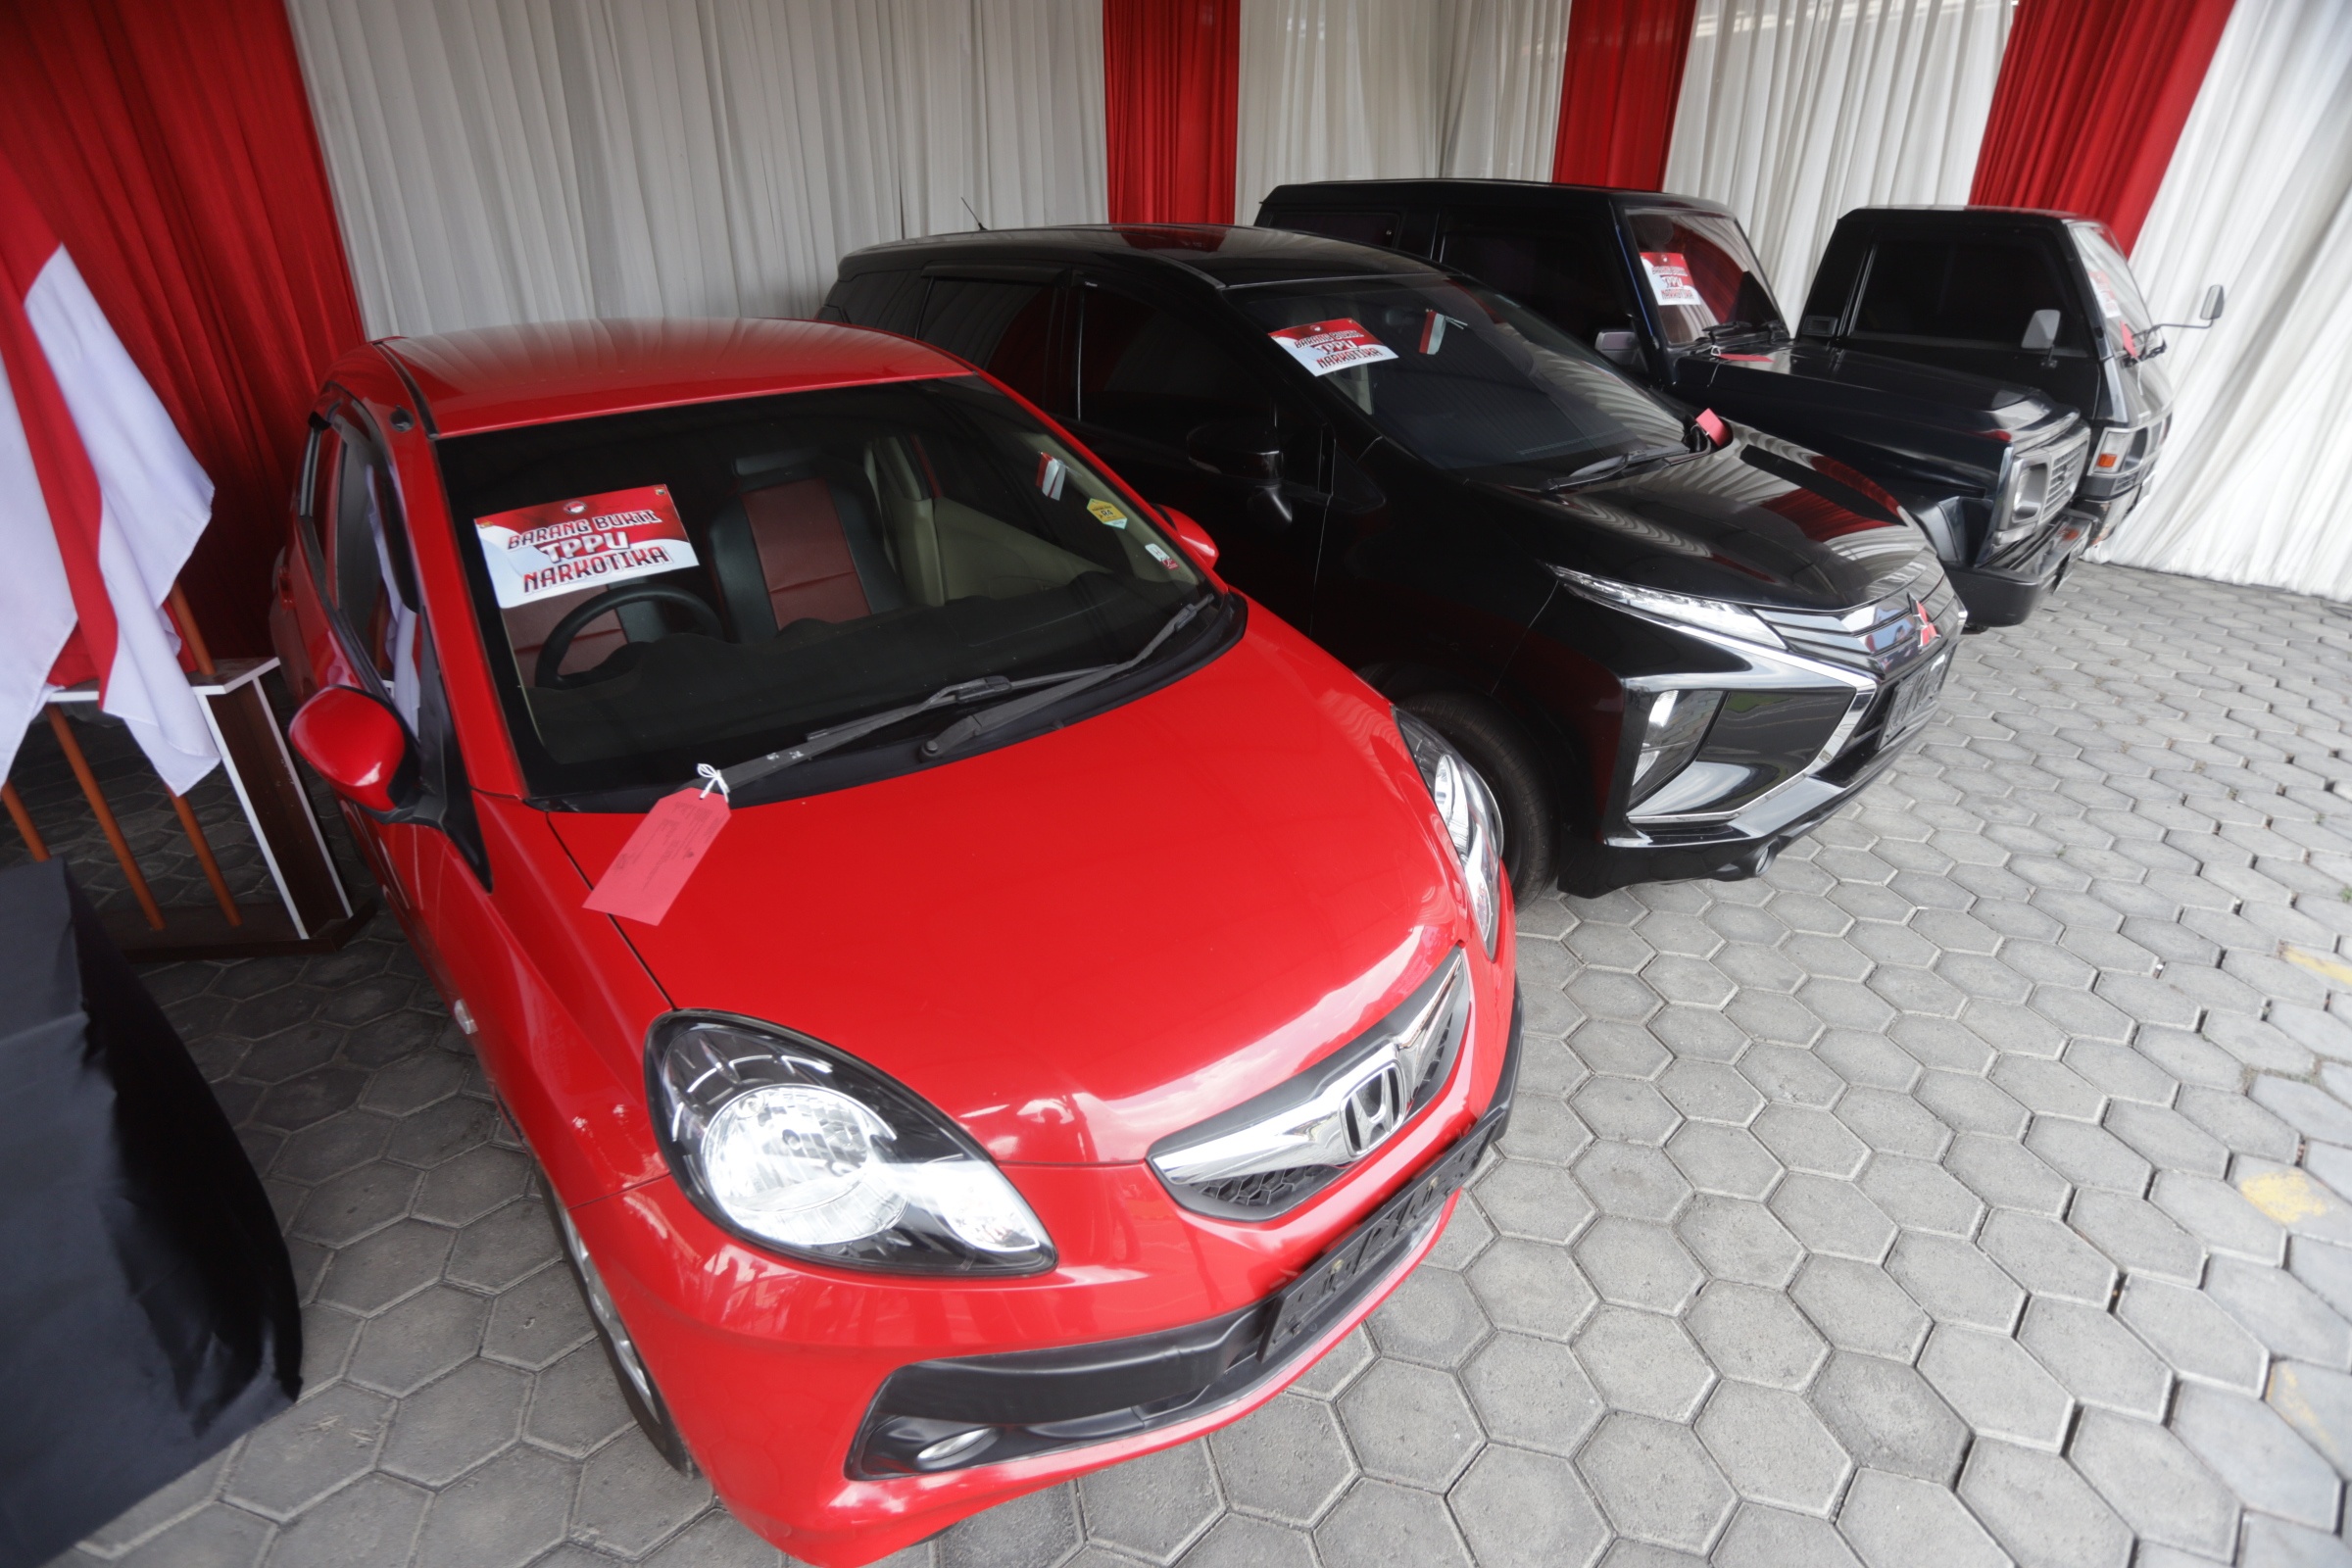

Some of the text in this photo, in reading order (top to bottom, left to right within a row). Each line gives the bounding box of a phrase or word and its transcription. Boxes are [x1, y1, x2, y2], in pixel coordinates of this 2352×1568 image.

[1314, 340, 1359, 354] TPPU
[1316, 348, 1383, 368] NARKOTIKA
[508, 509, 662, 550] BARANG BUKTI
[541, 531, 631, 564] TPPU
[522, 545, 672, 593] NARKOTIKA
